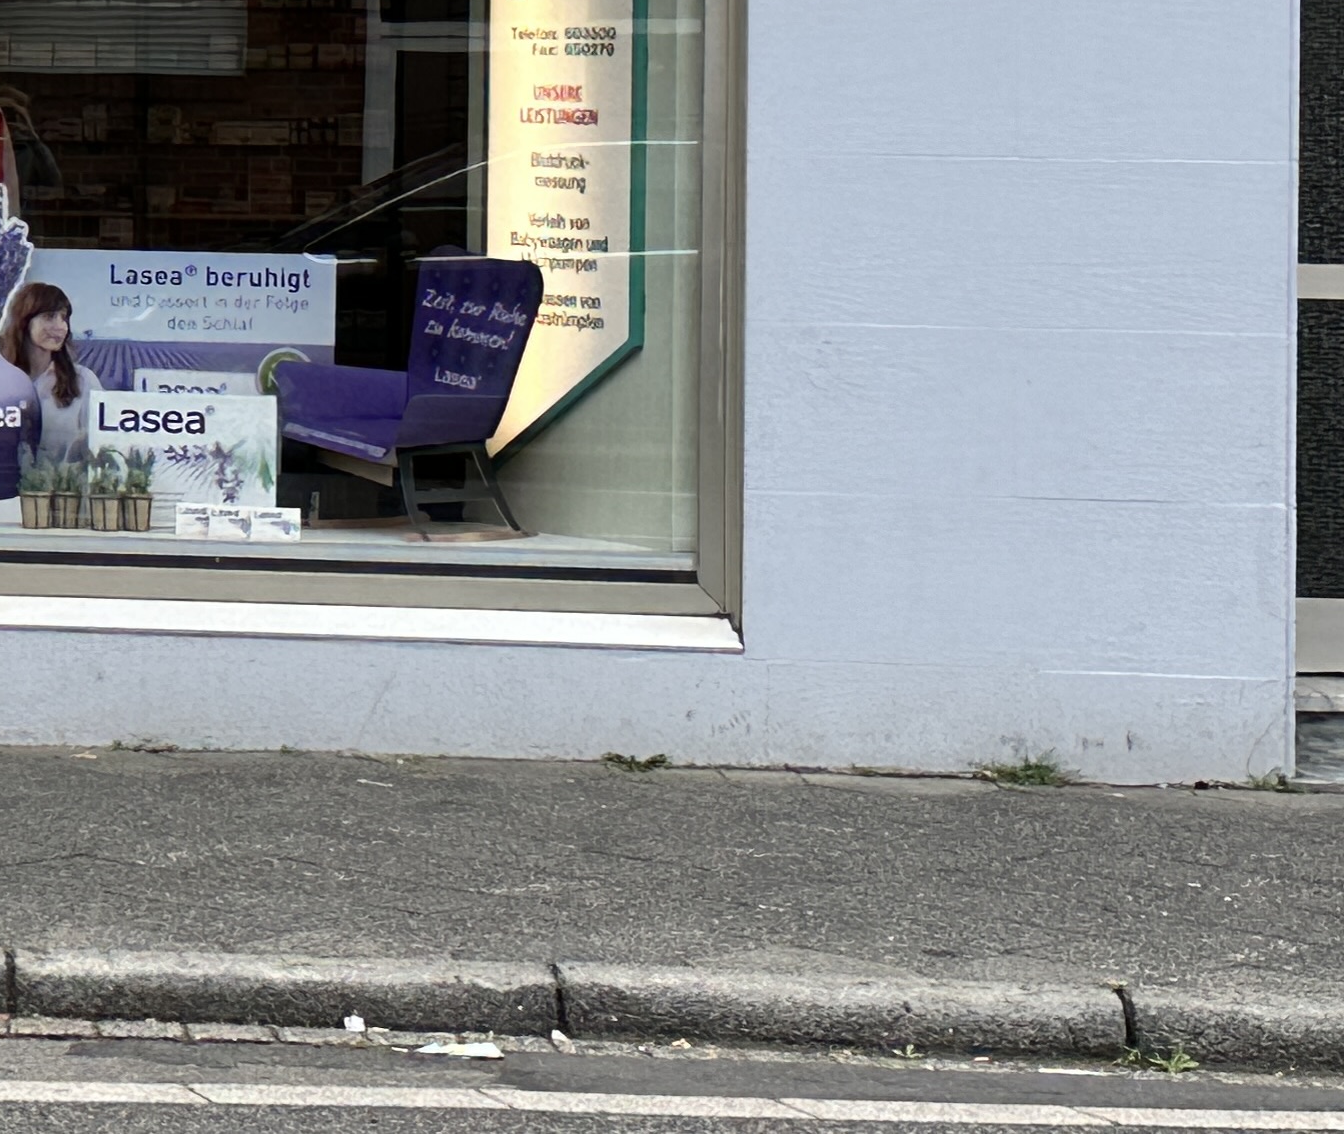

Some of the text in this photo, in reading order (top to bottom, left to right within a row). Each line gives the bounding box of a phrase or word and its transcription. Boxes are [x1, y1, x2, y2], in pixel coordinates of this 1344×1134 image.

[205, 265, 312, 293] beruhigt
[110, 294, 142, 308] und
[233, 295, 261, 311] der
[265, 294, 311, 315] Folge
